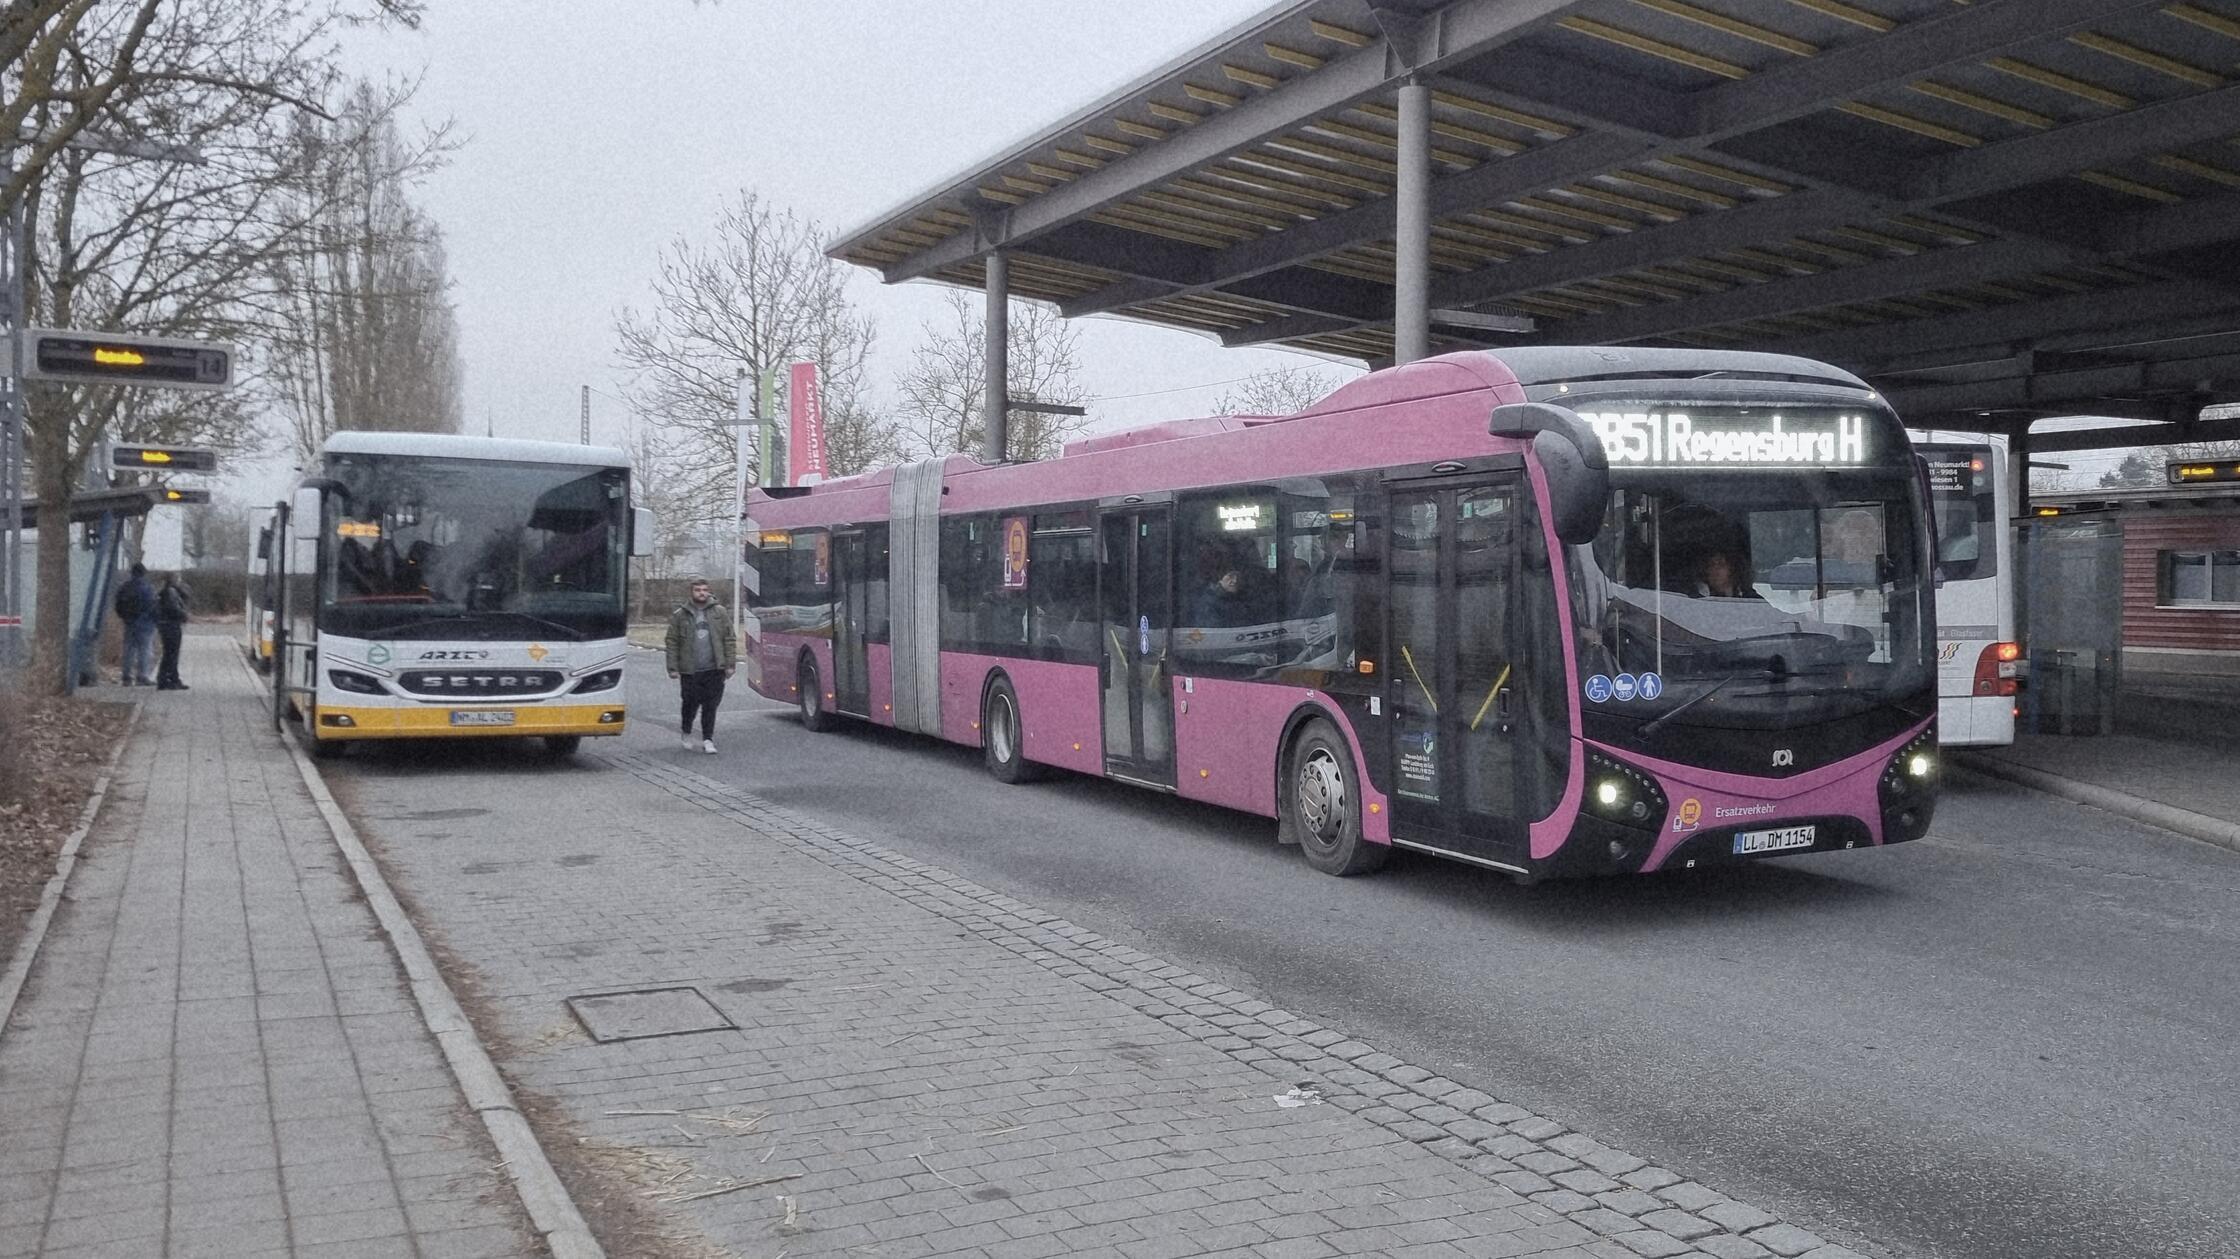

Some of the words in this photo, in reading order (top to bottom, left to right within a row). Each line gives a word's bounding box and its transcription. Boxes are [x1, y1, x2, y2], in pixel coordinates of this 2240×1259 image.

[805, 380, 821, 470] NEUMARKT
[1667, 414, 1834, 461] Regensburg
[1839, 416, 1862, 461] H
[421, 676, 544, 687] SETRA
[1715, 803, 1777, 818] Ersatzverkehr
[1743, 833, 1758, 851] LL
[1767, 831, 1782, 848] DM
[1785, 827, 1814, 847] 1154
